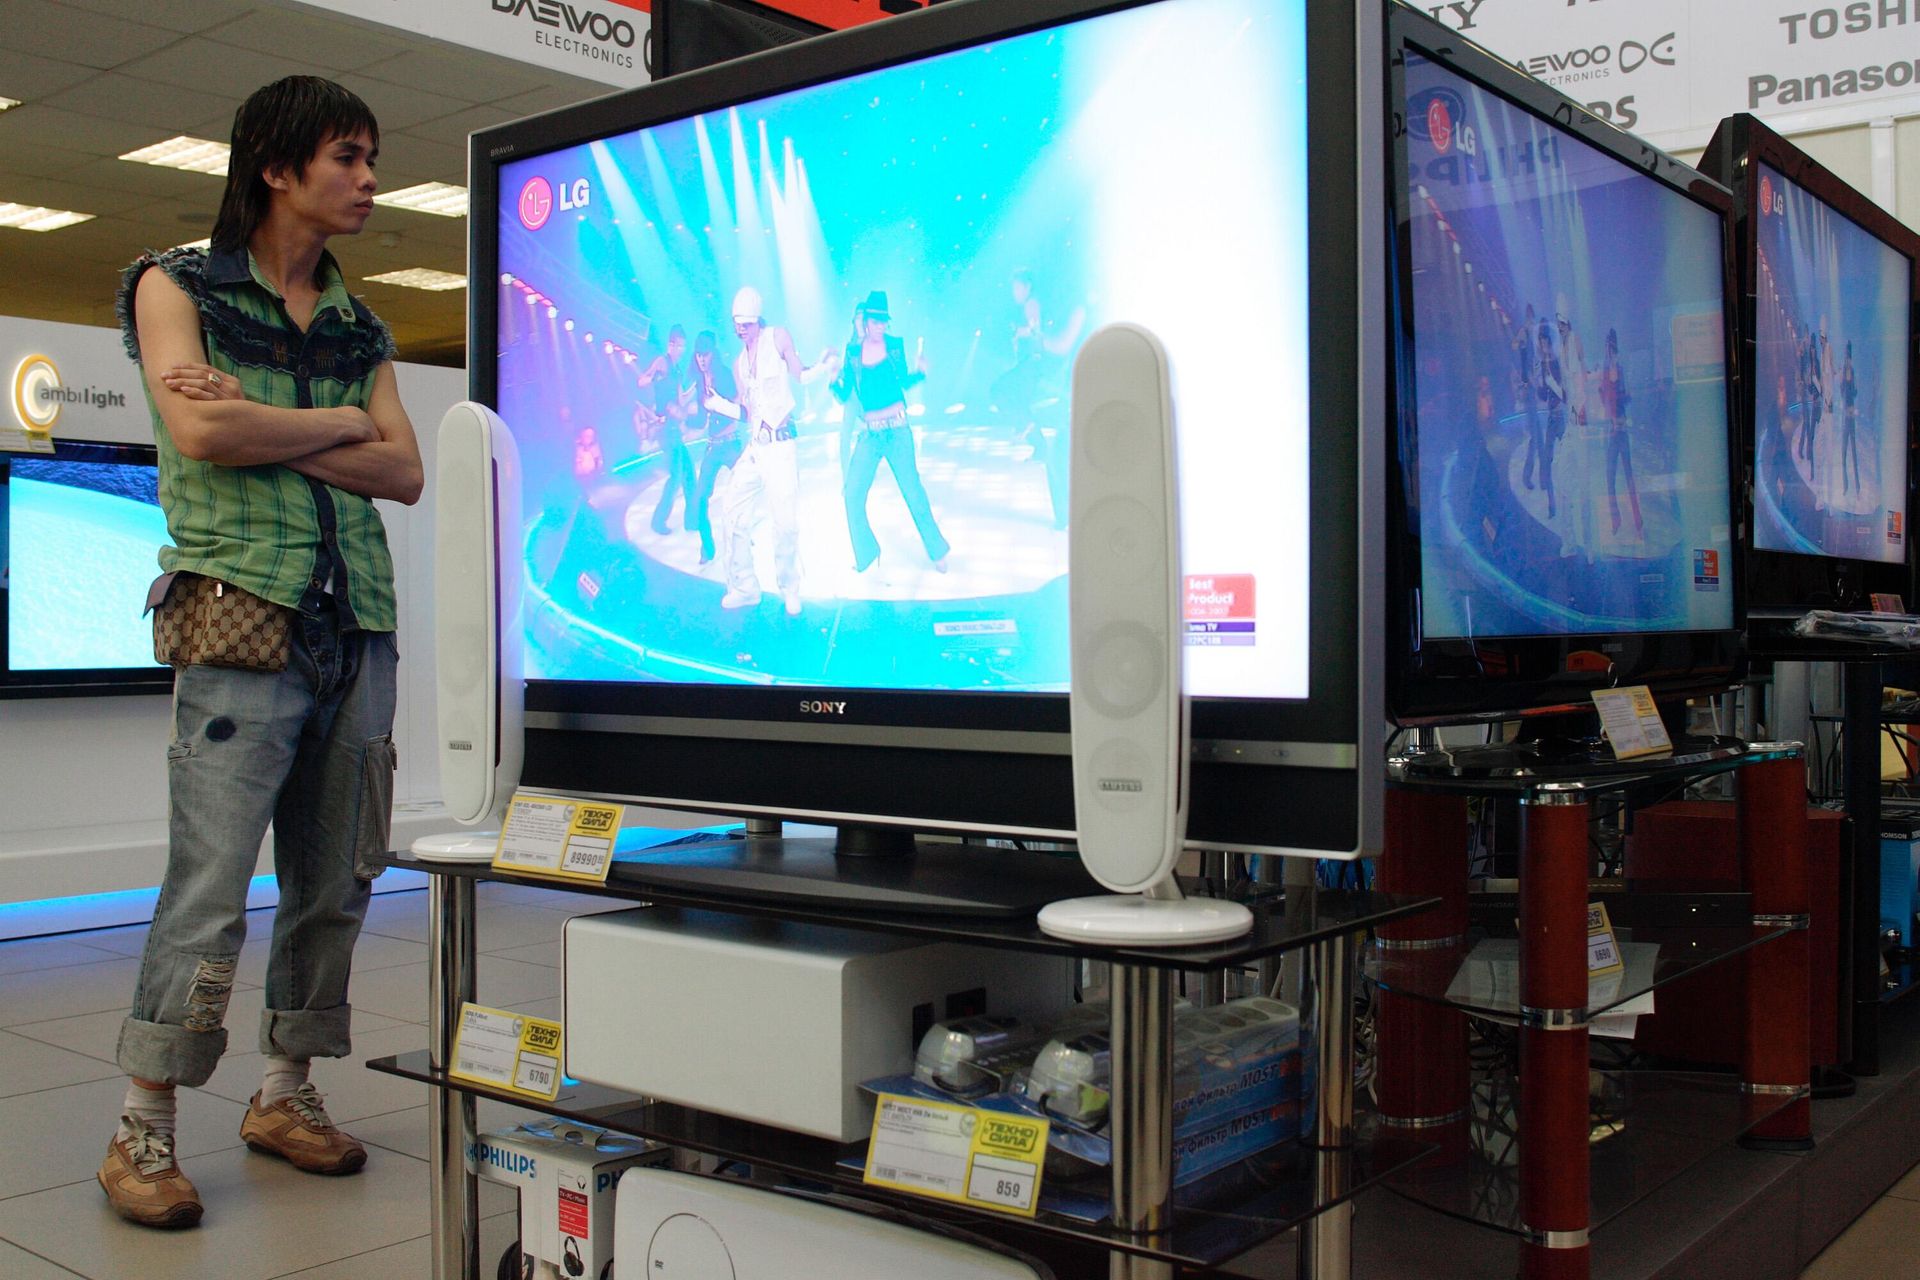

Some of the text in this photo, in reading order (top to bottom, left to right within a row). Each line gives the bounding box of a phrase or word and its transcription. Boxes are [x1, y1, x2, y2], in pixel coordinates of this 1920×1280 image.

[535, 30, 633, 69] ELECTRONICS
[1515, 45, 1611, 77] AEWOO
[1543, 67, 1611, 86] CTRONICS
[1748, 59, 1920, 110] Panaso
[1455, 121, 1476, 156] LG
[490, 144, 515, 157] BRAVIA
[559, 178, 590, 212] LG
[1772, 190, 1784, 216] LG
[40, 385, 126, 409] ambilight
[799, 700, 847, 715] SONY
[1880, 831, 1908, 840] HOMSON
[530, 1025, 558, 1038] ТЕХНО
[988, 1120, 1034, 1138] ТЕХНО
[988, 1133, 1029, 1149] СИЛА
[480, 1142, 537, 1179] PHILIPS
[996, 1179, 1021, 1199] 859
